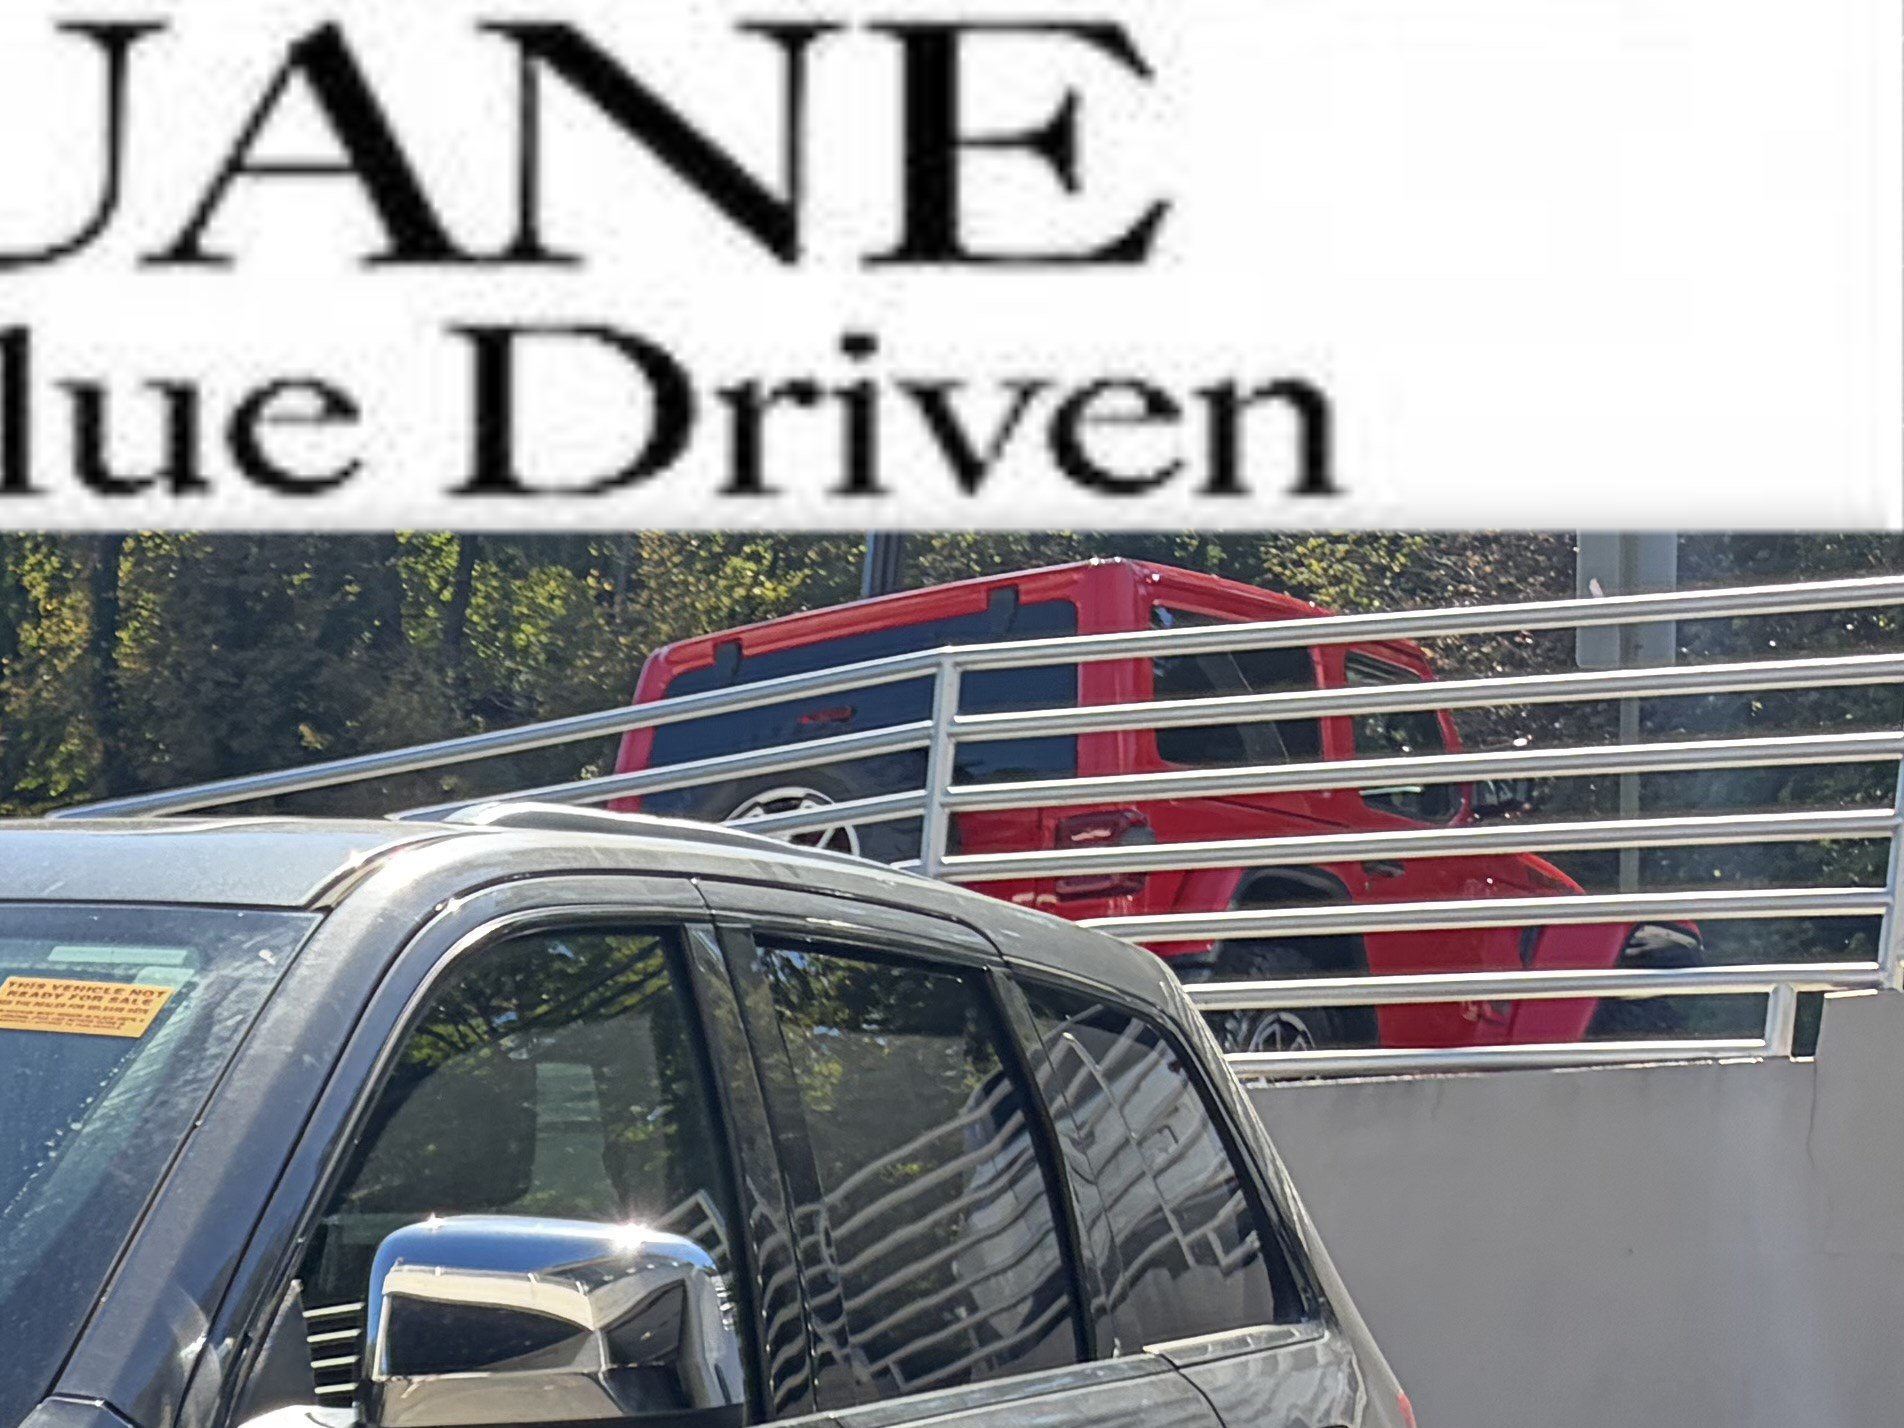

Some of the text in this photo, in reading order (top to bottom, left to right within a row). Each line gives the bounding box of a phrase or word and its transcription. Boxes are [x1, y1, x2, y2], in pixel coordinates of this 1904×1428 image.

[51, 983, 123, 996] VEHICLE
[129, 988, 167, 999] NOT
[108, 995, 154, 1006] SALE
